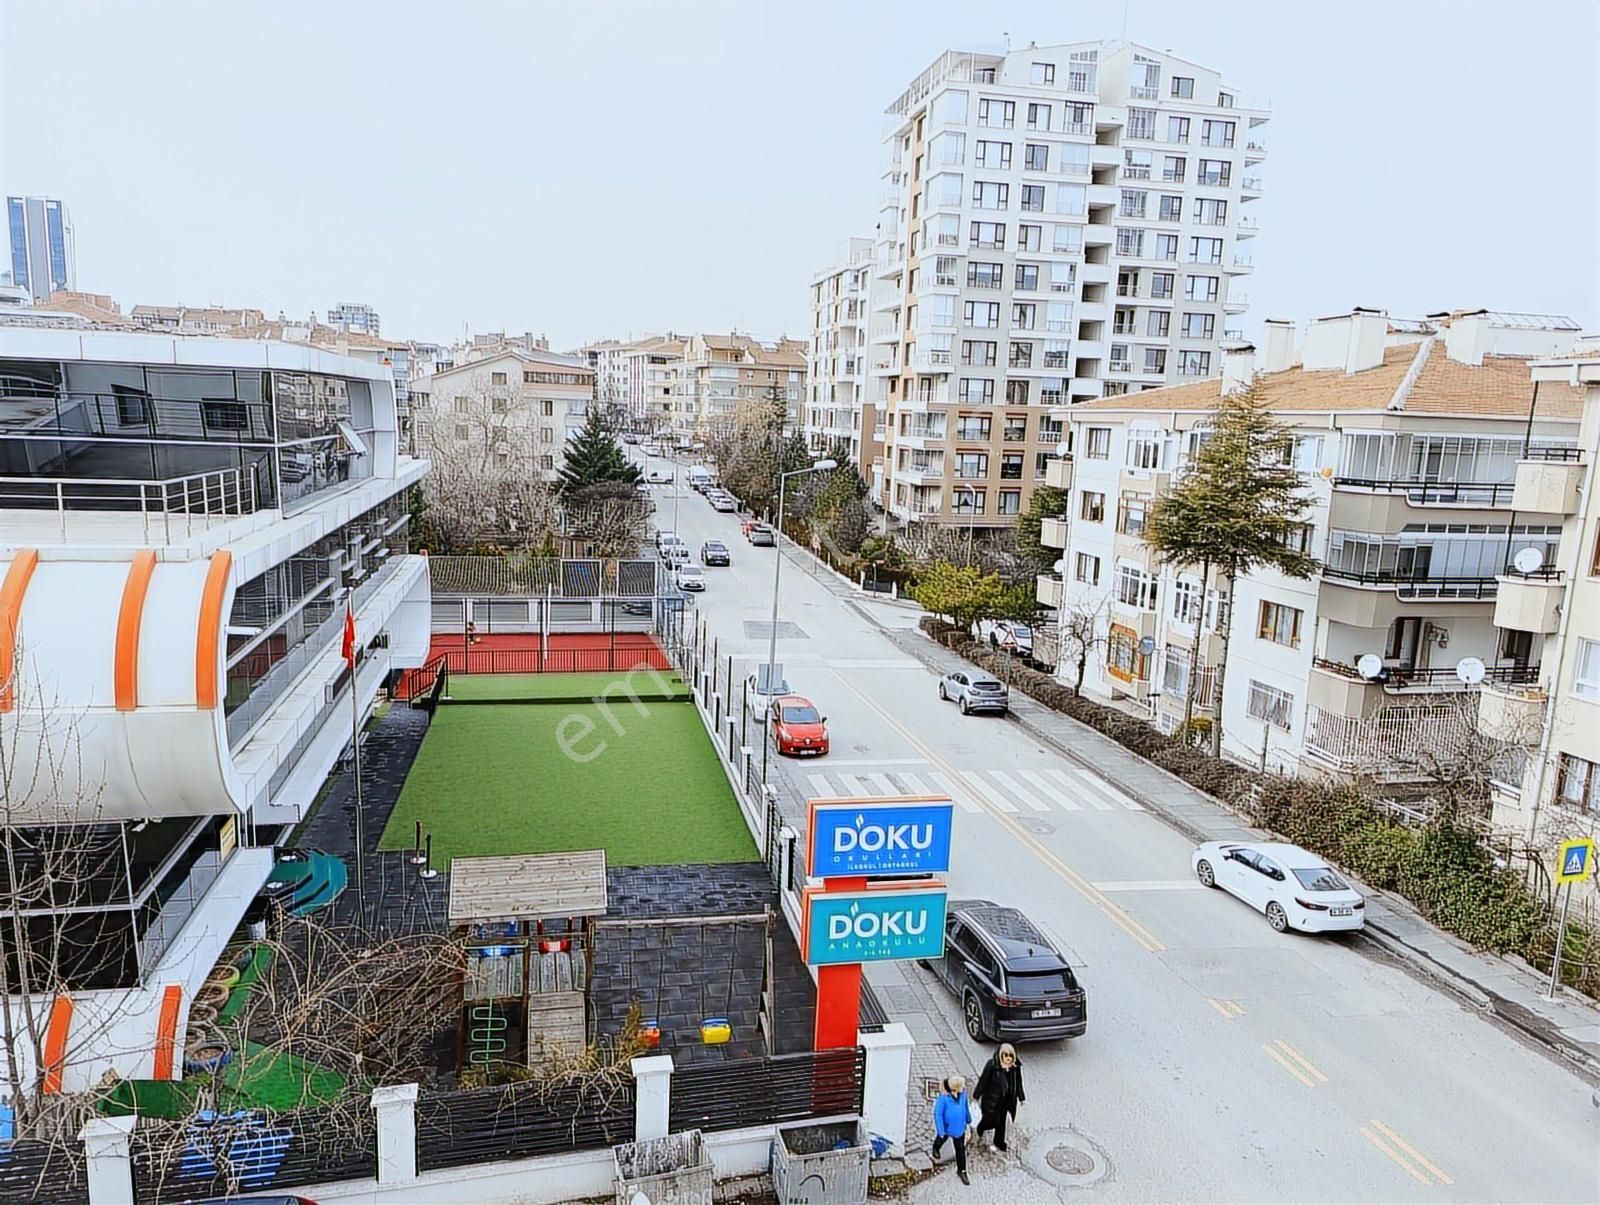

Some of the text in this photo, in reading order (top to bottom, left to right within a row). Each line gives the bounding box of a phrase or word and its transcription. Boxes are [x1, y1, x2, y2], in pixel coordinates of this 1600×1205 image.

[834, 824, 933, 853] DOKU
[833, 852, 932, 863] OKULLARI
[829, 910, 927, 940] DOKU
[828, 937, 926, 951] ANAOKULU
